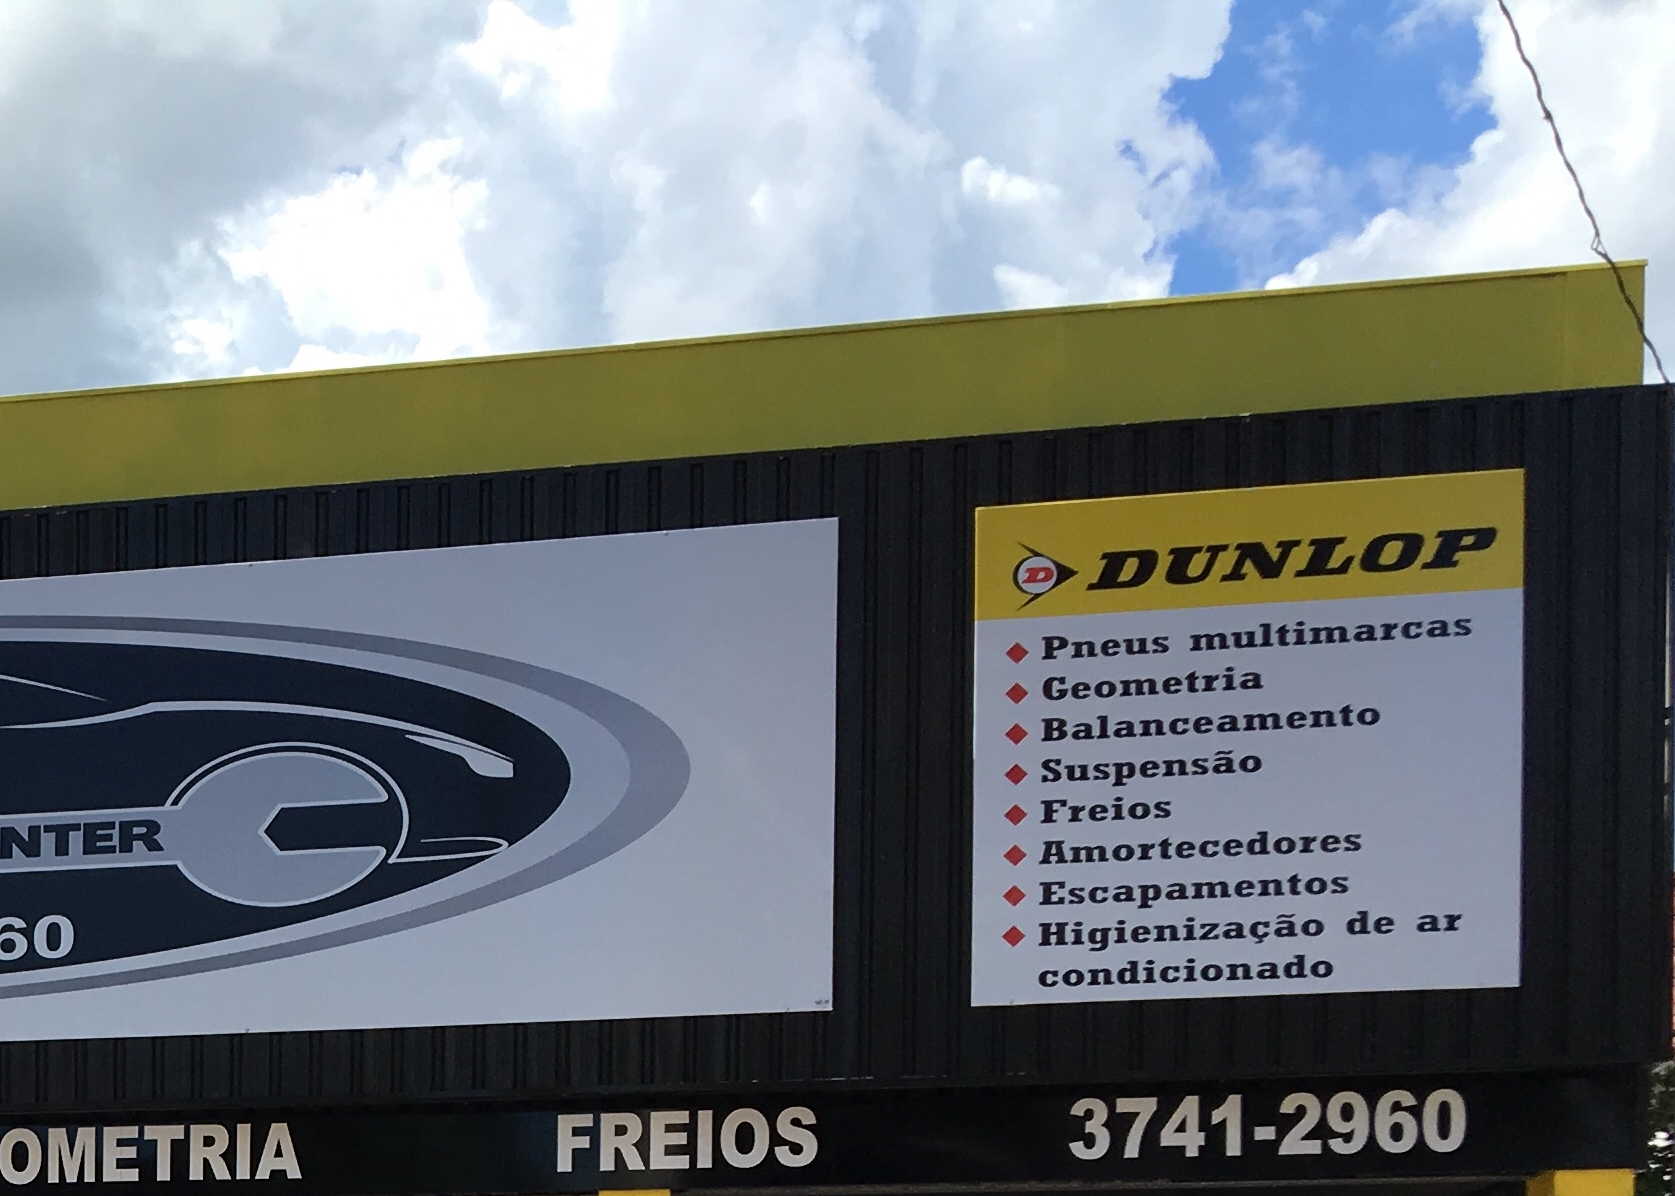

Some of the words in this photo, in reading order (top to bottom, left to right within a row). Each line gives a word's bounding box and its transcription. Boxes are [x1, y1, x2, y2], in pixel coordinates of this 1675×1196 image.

[1085, 526, 1498, 592] DUNLOP
[1041, 634, 1170, 661] Pneus
[1189, 617, 1472, 652] multimarcas
[1042, 666, 1264, 702] Geometria
[1040, 704, 1381, 743] Balanceamento
[1040, 750, 1263, 788] Suspensão
[1040, 796, 1172, 825] Freios
[1038, 830, 1362, 866] Amortecedores
[1038, 873, 1349, 910] Escapamentos
[1038, 913, 1325, 952] Higienização
[1346, 910, 1395, 936] de
[1416, 913, 1462, 934] ar
[1038, 954, 1334, 988] condicionado
[556, 1106, 819, 1173] FREIOS
[1068, 1089, 1467, 1160] 3741-2960
